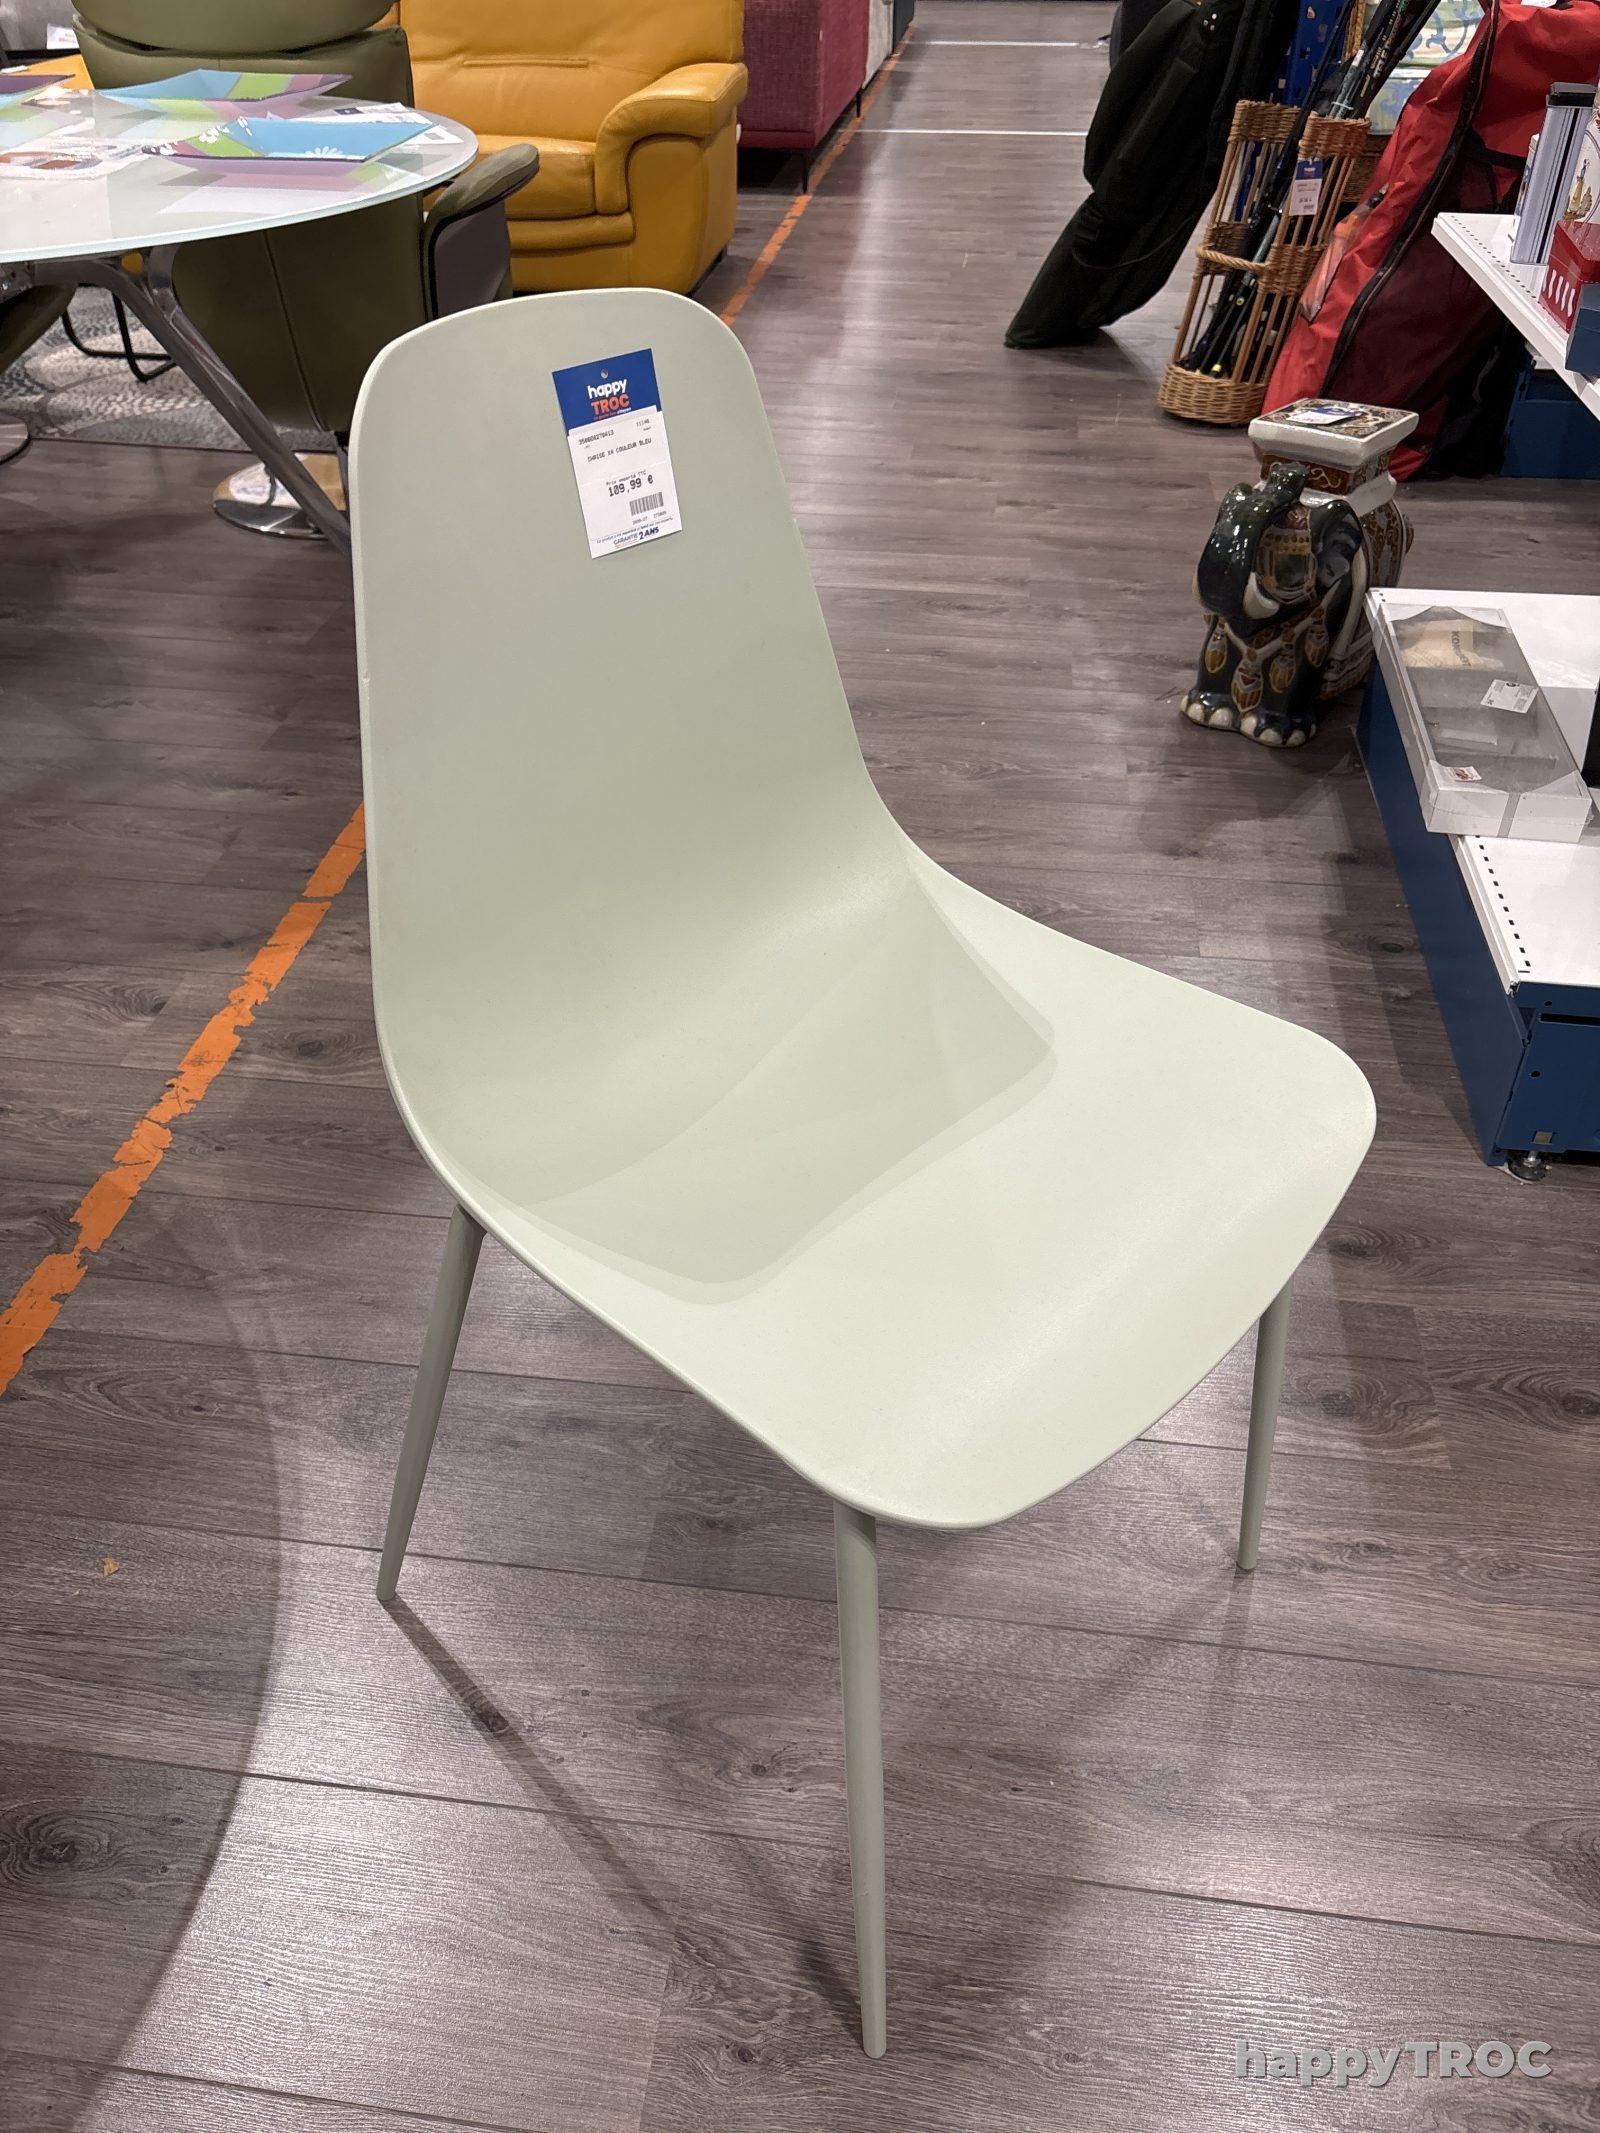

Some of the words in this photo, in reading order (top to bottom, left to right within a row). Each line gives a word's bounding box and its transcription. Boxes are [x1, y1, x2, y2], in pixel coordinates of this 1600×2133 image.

[587, 379, 627, 399] happy
[591, 394, 630, 415] TROC
[615, 442, 637, 453] COULEUR
[639, 438, 652, 446] BLEU
[608, 478, 642, 497] 109,99
[647, 474, 654, 485] €
[638, 531, 645, 541] 2
[644, 527, 660, 537] ANS
